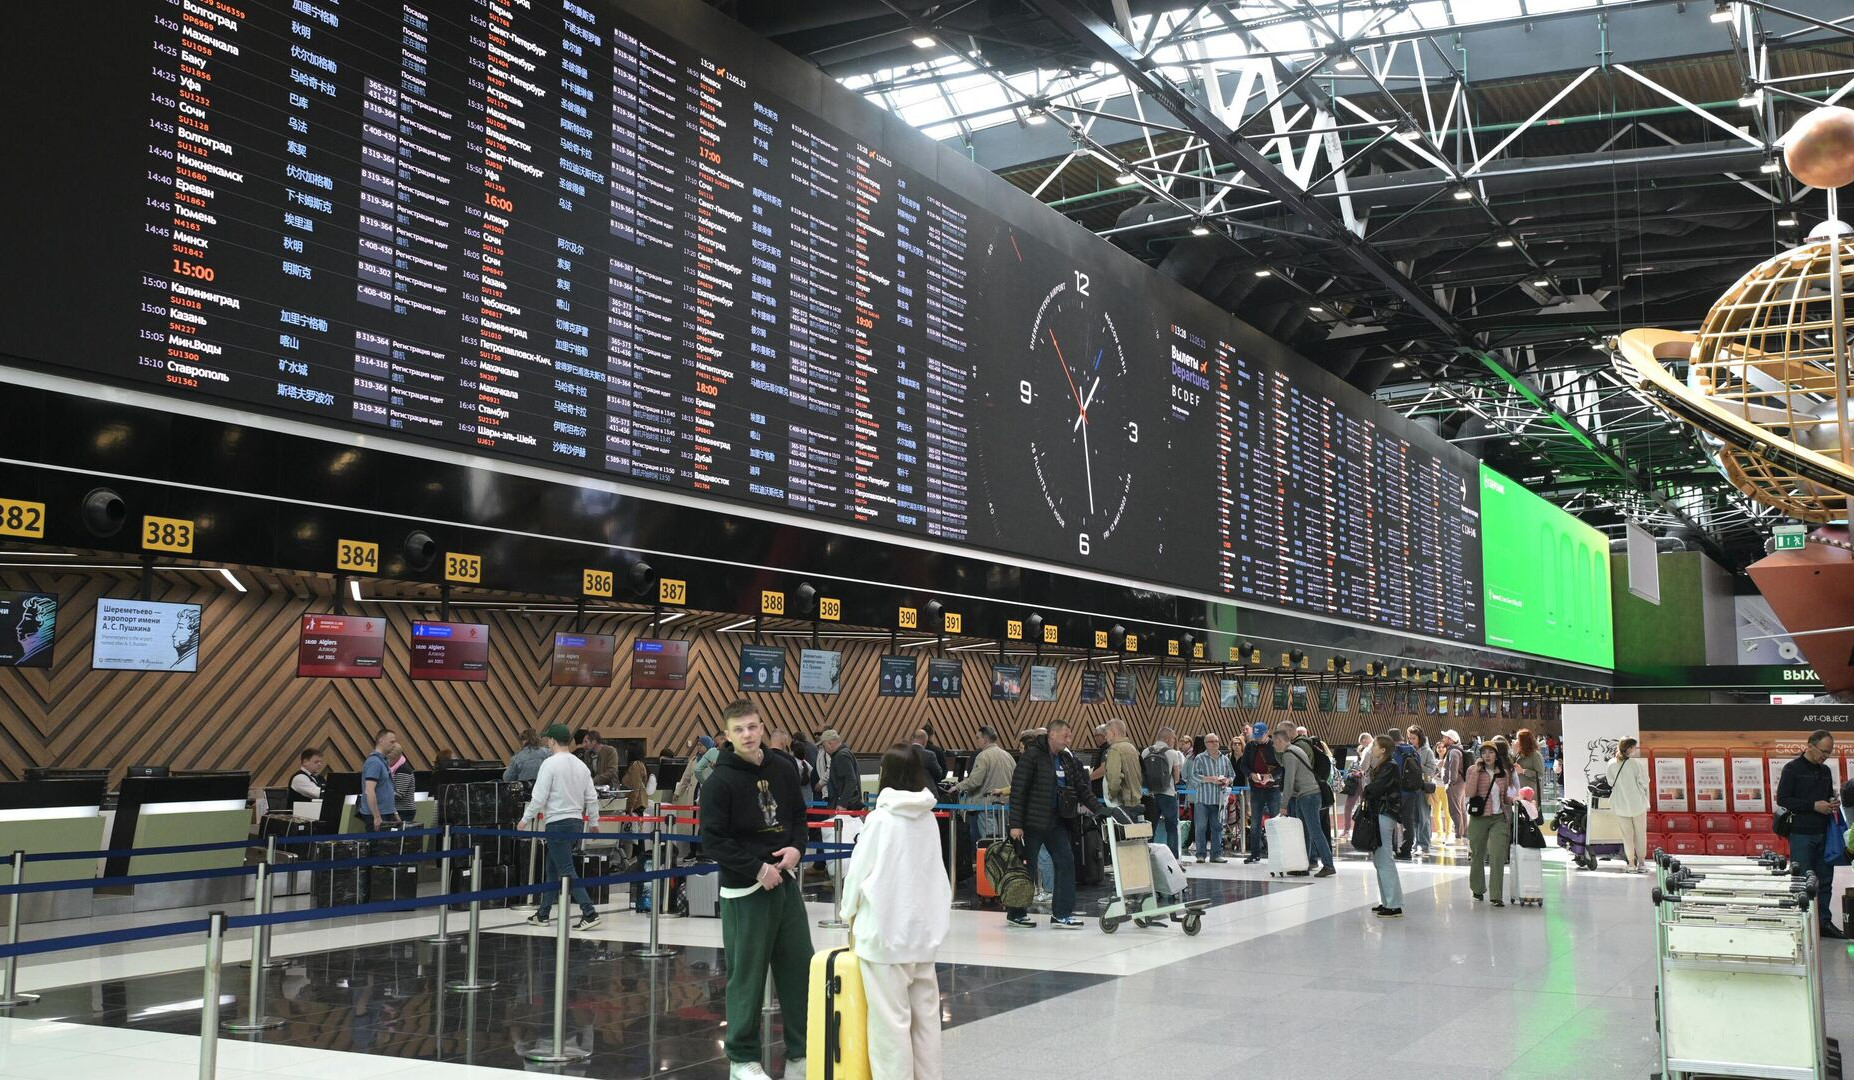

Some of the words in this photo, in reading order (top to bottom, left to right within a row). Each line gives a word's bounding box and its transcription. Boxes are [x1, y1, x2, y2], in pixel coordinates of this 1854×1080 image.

[183, 0, 237, 32] Волгоград
[216, 2, 245, 20] SU6359
[183, 14, 214, 31] DP6969
[292, 21, 310, 39] 秋明
[154, 15, 178, 31] 14:20
[182, 25, 239, 56] Махачкала
[470, 14, 486, 28] 15:20
[489, 22, 546, 57] Санкт-Петербург
[153, 41, 177, 56] 14:25
[182, 50, 206, 69] Баку
[182, 39, 212, 56] SU1058
[488, 43, 536, 72] Екатеринбург
[701, 58, 715, 72] 13:28
[152, 67, 176, 82] 14:25
[180, 75, 201, 92] Уфа
[180, 64, 211, 81] SU1856
[369, 80, 396, 97] 365-373
[487, 85, 523, 108] Астрахань
[151, 93, 175, 108] 14:30
[179, 101, 205, 119] Сочи
[179, 90, 210, 106] SU1232
[290, 92, 308, 109] 巴库
[368, 90, 396, 107] 431-436
[401, 92, 437, 113] Регистрация
[364, 101, 369, 109] B
[369, 102, 396, 120] 319-364
[178, 115, 209, 131] SU1128
[288, 116, 308, 134] 乌法
[150, 119, 173, 133] 14:35
[178, 127, 232, 156] Волгоград
[363, 123, 368, 132] C
[369, 126, 396, 142] 408-430
[467, 120, 483, 133] 15:40
[486, 127, 531, 152] Владивосток
[177, 141, 208, 157] SU1182
[700, 147, 721, 164] 17:00
[149, 145, 173, 160] 14:40
[177, 153, 243, 183] Нижнекамск
[176, 167, 207, 182] SU1680
[148, 171, 172, 185] 14:40
[176, 178, 214, 199] Ереван
[175, 192, 206, 208] SU1862
[484, 192, 512, 212] 16:00
[146, 197, 170, 211] 14:45
[175, 204, 216, 226] Тюмень
[483, 212, 509, 228] Алжир
[174, 218, 200, 232] N4163
[145, 224, 170, 237] 14:45
[174, 230, 208, 249] Минск
[283, 237, 303, 253] 秋明
[173, 244, 204, 258] SU1842
[463, 249, 480, 260] 16:05
[482, 254, 500, 267] Сочи
[173, 259, 214, 281] 15:00
[283, 261, 311, 280] 明斯克
[482, 275, 507, 290] Казань
[1074, 270, 1089, 296] 12
[142, 276, 167, 289] 15:00
[171, 282, 240, 310] Калининград
[171, 296, 201, 310] SU1018
[462, 292, 479, 303] 16:10
[482, 296, 520, 315] Чебоксары
[141, 303, 166, 316] 15:00
[170, 308, 207, 326] Казань
[1030, 296, 1050, 351] SHEREMETYEVO
[1050, 282, 1066, 299] AIRPORT
[462, 314, 478, 324] 16:30
[480, 318, 527, 339] Калининград
[1175, 325, 1187, 339] 13:28
[140, 330, 164, 342] 15:05
[169, 334, 221, 355] Мин.Воды
[1105, 312, 1119, 343] MOSCOW
[1118, 345, 1127, 375] RUSSIA
[168, 349, 199, 361] SU1300
[355, 354, 361, 362] B
[361, 356, 388, 368] 314-316
[1172, 345, 1198, 371] Вылеты
[139, 356, 163, 368] 15:10
[168, 361, 229, 382] Ставрополь
[460, 357, 477, 367] 16:45
[480, 361, 519, 378] Махачкала
[1172, 361, 1210, 390] Departures
[167, 375, 197, 387] SU1362
[696, 382, 718, 396] 18:00
[1020, 380, 1032, 404] 9
[1172, 385, 1176, 396] B
[1178, 388, 1182, 399] C
[1184, 390, 1188, 402] D
[1190, 393, 1194, 404] E
[1196, 396, 1200, 406] F
[353, 401, 359, 410] B
[360, 402, 386, 416] 319-364
[459, 401, 475, 411] 16:45
[478, 404, 509, 419] Стамбул
[696, 398, 716, 410] Ереван
[458, 423, 475, 433] 16:50
[478, 426, 536, 446] Шарм-эль-Шейх
[1128, 421, 1138, 443] 3
[695, 471, 730, 485] Владивосток
[1034, 456, 1046, 491] FLIGHTS
[1045, 491, 1054, 510] LAST
[0, 504, 40, 531] 82
[146, 521, 190, 548] 383
[1078, 533, 1090, 555] 6
[341, 544, 377, 568] 384
[448, 556, 479, 579] 385
[585, 574, 611, 594] 386
[661, 583, 684, 601] 387
[104, 606, 153, 615] Шереметьево
[763, 594, 783, 611] 388
[822, 601, 839, 618] 389
[900, 610, 915, 625] 390
[946, 616, 960, 630] 391
[119, 624, 151, 632] Пушкина
[1008, 624, 1022, 636] 392
[1045, 628, 1057, 640] 393
[1096, 634, 1107, 645] 394
[1127, 637, 1137, 648] 395
[1169, 642, 1178, 653] 396
[1194, 646, 1203, 656] 397
